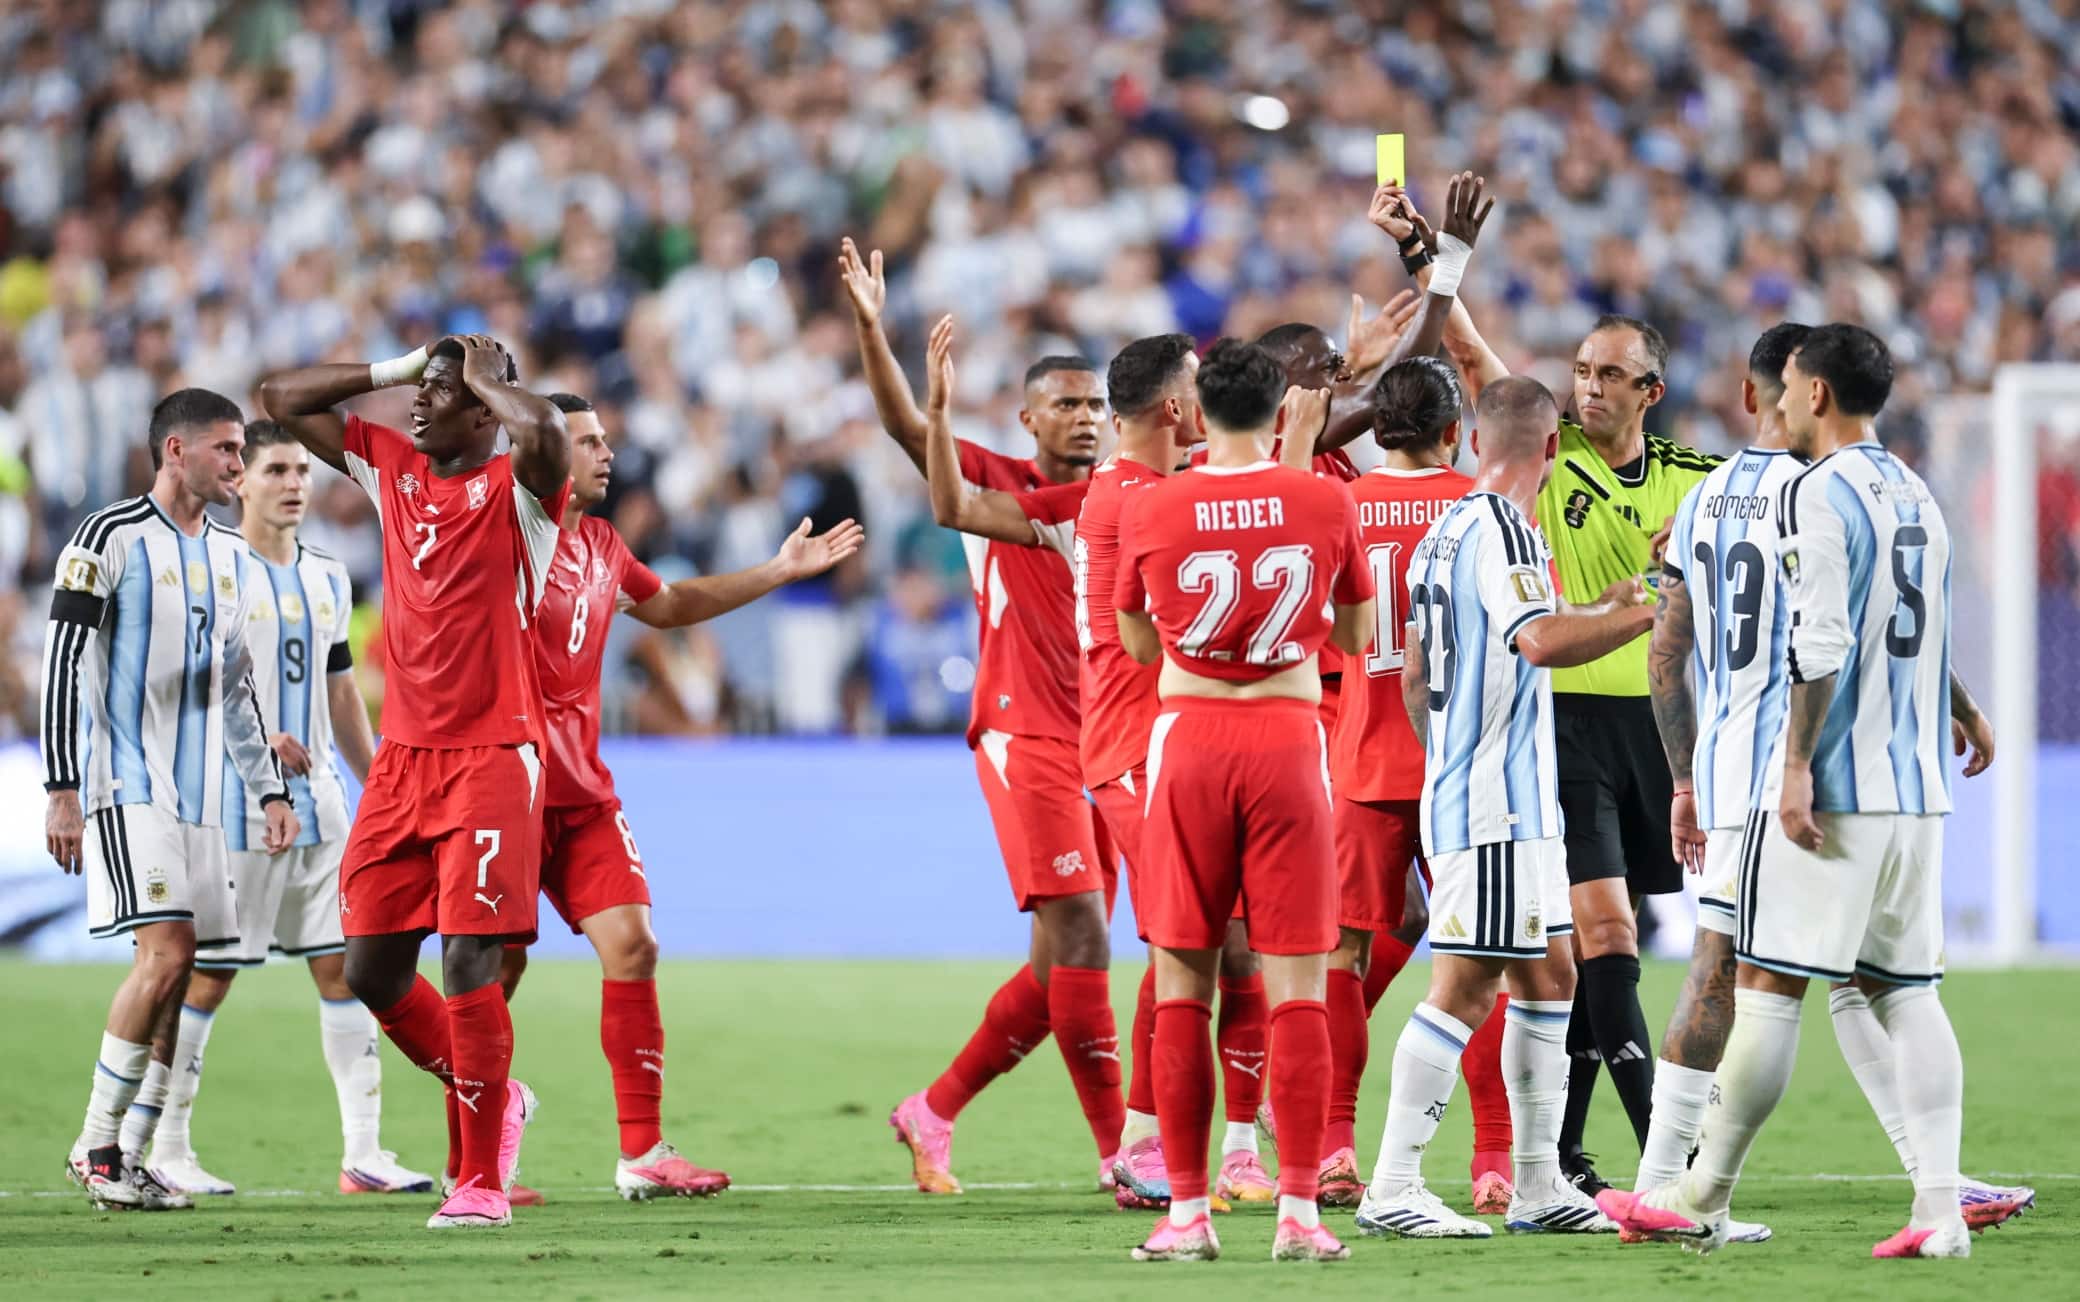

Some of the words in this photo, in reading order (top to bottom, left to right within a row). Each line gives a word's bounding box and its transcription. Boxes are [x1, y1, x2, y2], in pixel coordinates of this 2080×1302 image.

[1194, 496, 1284, 532] RIEDER
[1704, 494, 1769, 520] ROMERO
[412, 522, 437, 570] 7
[1176, 543, 1314, 664] 22
[1694, 541, 1765, 672] 13
[1886, 525, 1928, 658] 5
[191, 605, 208, 654] 7
[568, 596, 589, 654] 8
[284, 637, 305, 685] 9
[475, 829, 501, 888] 7
[615, 810, 641, 863] 8
